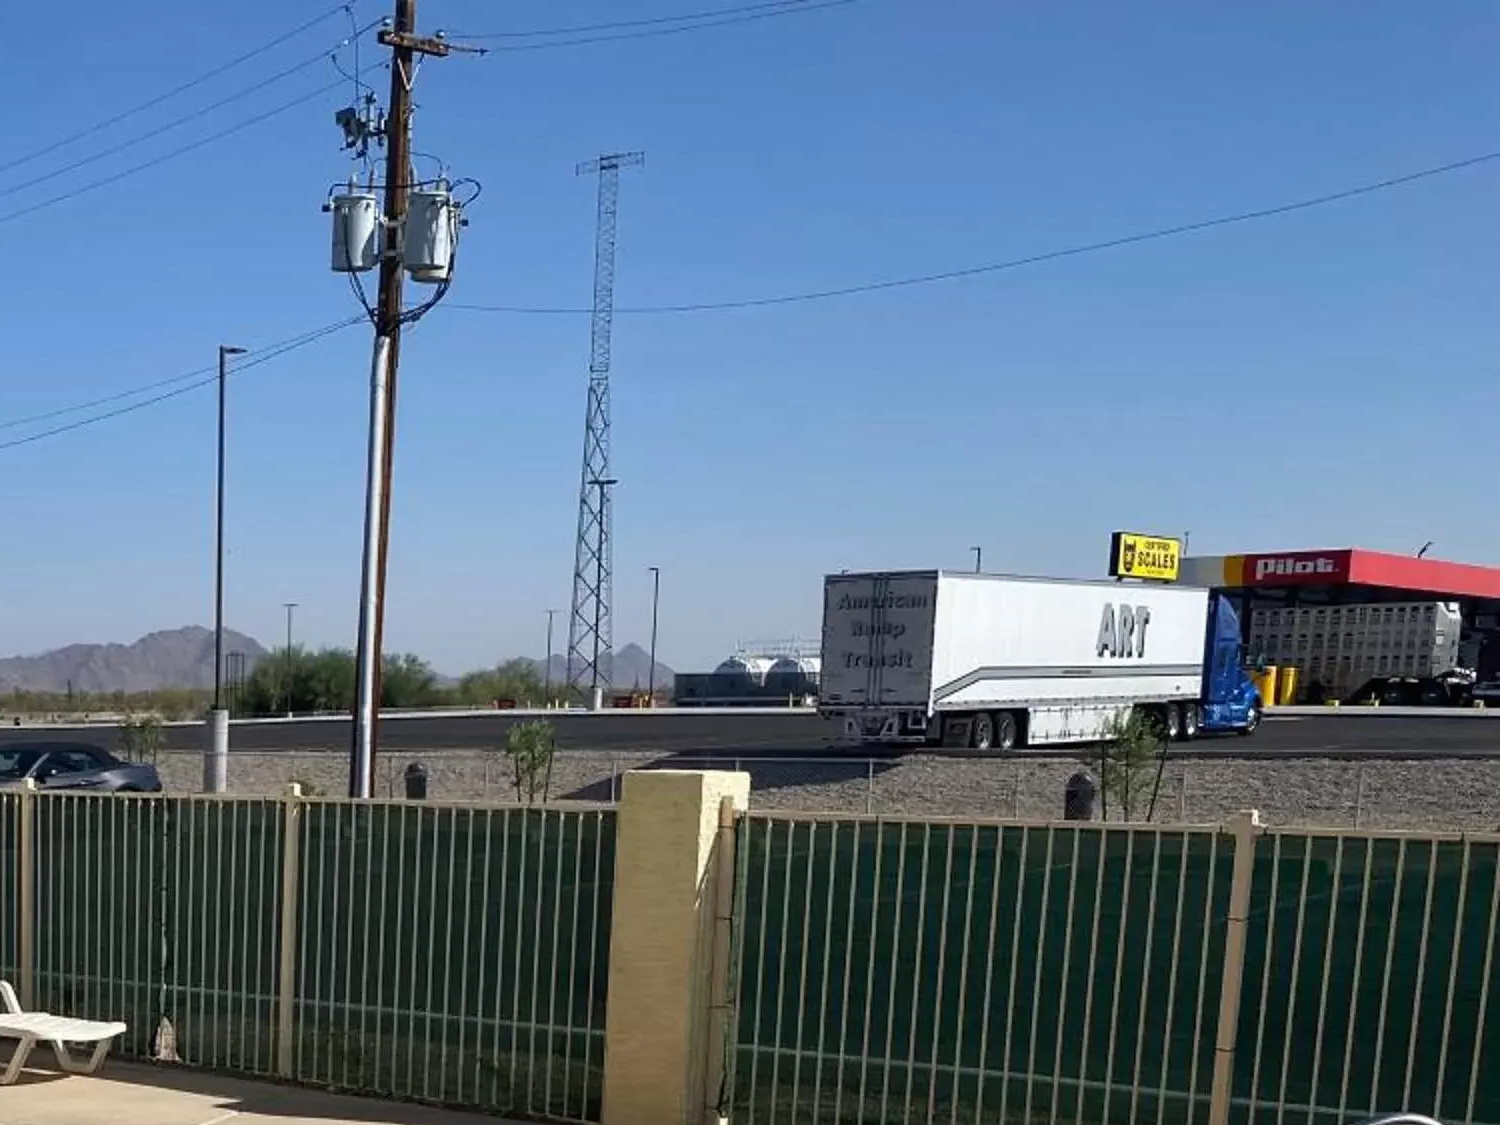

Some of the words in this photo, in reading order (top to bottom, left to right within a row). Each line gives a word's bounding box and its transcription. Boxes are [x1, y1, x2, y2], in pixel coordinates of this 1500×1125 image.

[1138, 551, 1175, 569] SCALES
[1256, 558, 1333, 580] Pilot
[1096, 602, 1151, 658] ART
